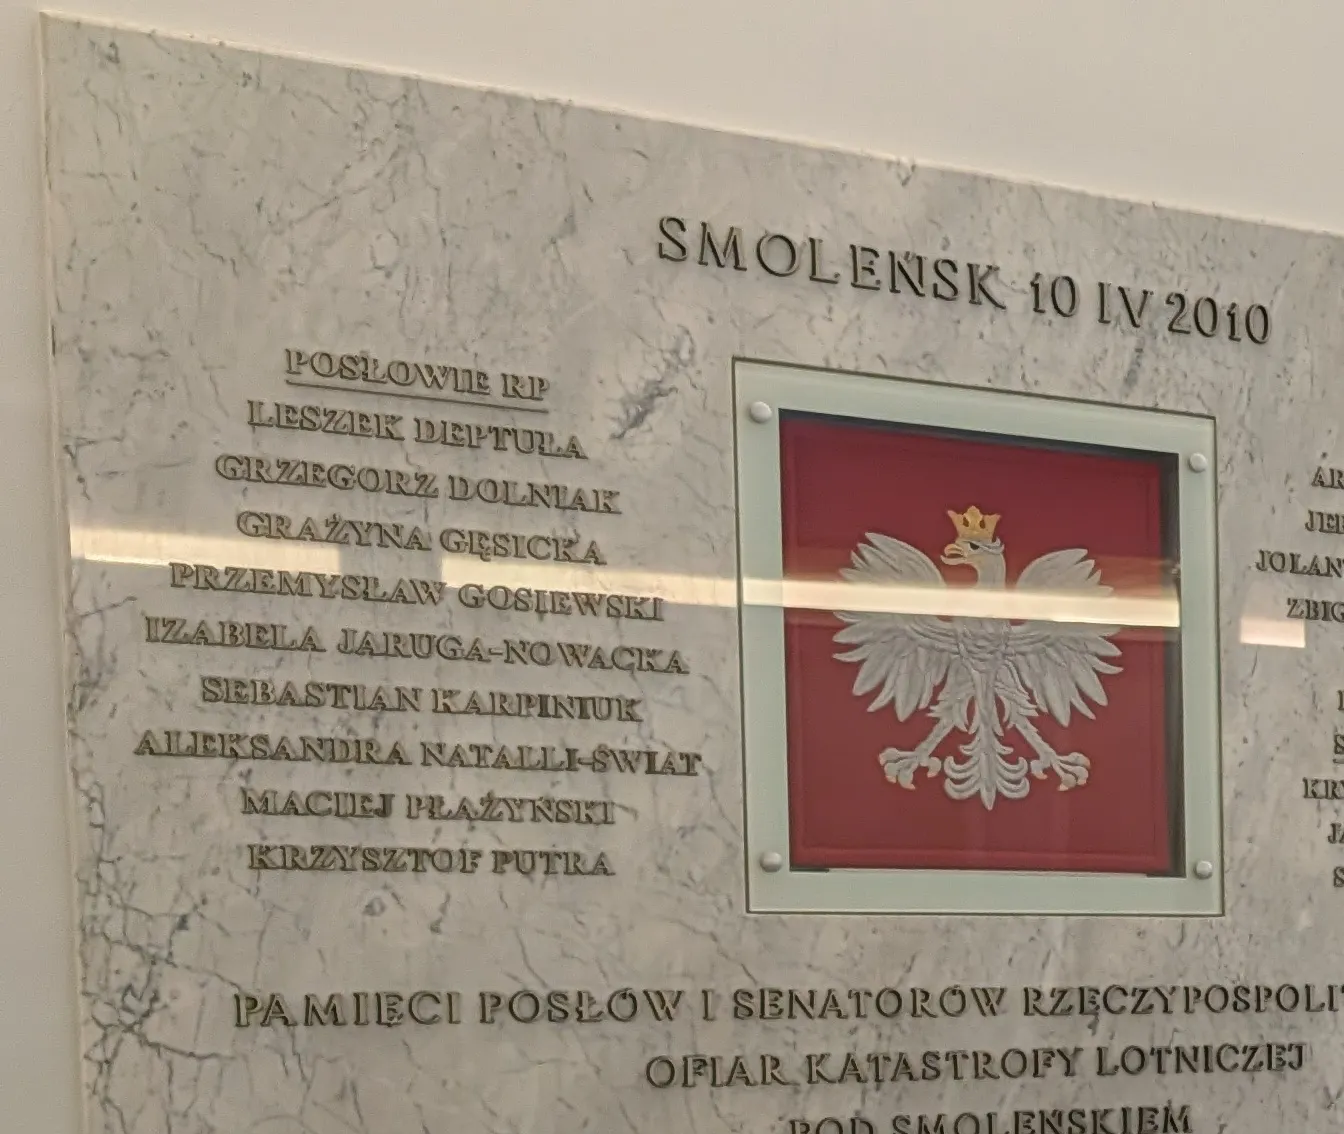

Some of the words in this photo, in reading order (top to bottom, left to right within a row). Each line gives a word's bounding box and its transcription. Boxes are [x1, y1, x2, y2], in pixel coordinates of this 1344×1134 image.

[1030, 270, 1077, 317] 10
[1098, 281, 1154, 328] IV
[1166, 291, 1271, 344] 2010
[285, 348, 489, 395] POSŁOWIE
[502, 373, 550, 401] RP
[248, 399, 404, 441] LESZEK
[415, 416, 588, 460] DEPTUŁA
[216, 454, 439, 498] GRZEGORZ
[450, 475, 622, 514] DOLNIAK
[236, 510, 431, 552] GRAŻYNA
[440, 529, 607, 565] GĘSICKA
[170, 562, 445, 607] PRZEMYSŁAW
[458, 582, 665, 622] GOSIEWSKI
[145, 616, 326, 653] IZABELA
[336, 627, 689, 675] JARUGA-NOWACKA
[201, 676, 423, 713] SEBASTIAN
[431, 688, 643, 723] KARPINIUK
[135, 730, 412, 767] ALEKSANDRA
[420, 741, 703, 777] NATALLI-ŚWIAT
[241, 788, 395, 820] MACIEJ
[406, 791, 615, 824] PŁAŻYŃSKI
[247, 844, 482, 873] KRZYSZTOF
[492, 850, 615, 876] PUTRA
[235, 992, 462, 1028] PAMIĘCI
[479, 988, 685, 1025] POSŁÓW
[701, 989, 715, 1021] I
[733, 985, 1008, 1021] SENATORÓW
[646, 1054, 799, 1088] OFIAR
[807, 1046, 1084, 1086] KATASTROFY
[1097, 1041, 1308, 1076] LOTNICZEJ
